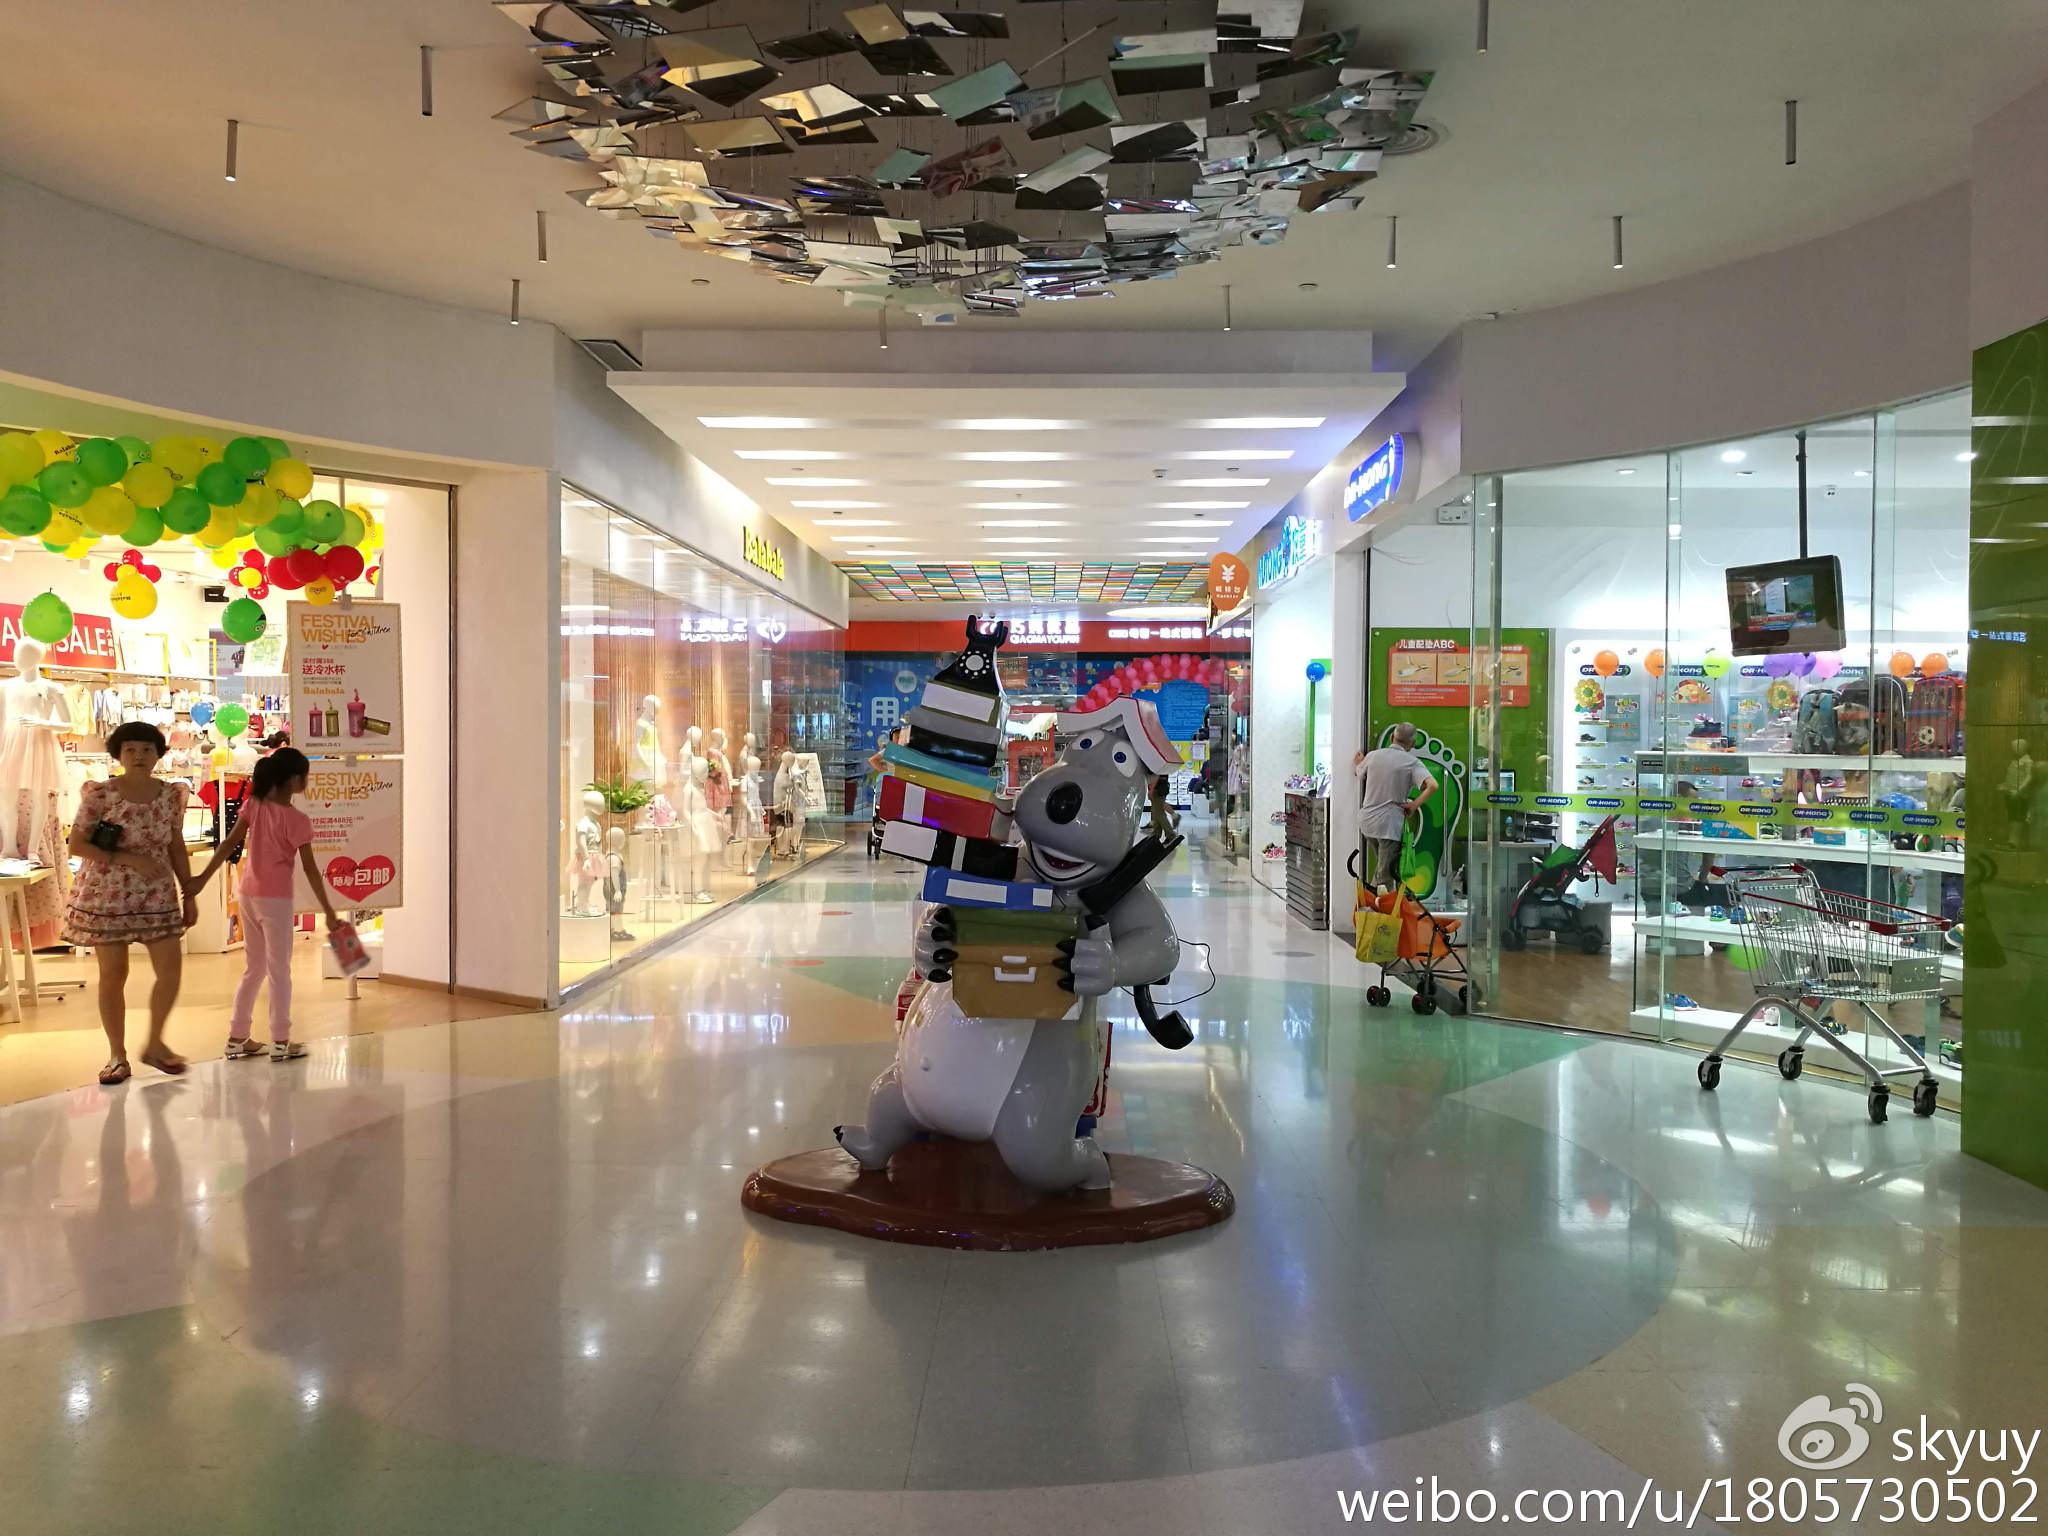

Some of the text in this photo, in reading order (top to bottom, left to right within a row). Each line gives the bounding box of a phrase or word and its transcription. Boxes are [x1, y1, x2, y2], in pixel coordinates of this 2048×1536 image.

[743, 526, 784, 580] Balabala
[301, 614, 376, 628] FESTIVAL
[302, 629, 367, 643] WISHES
[302, 664, 345, 675] 送冷水杯
[305, 787, 369, 800] WISHES
